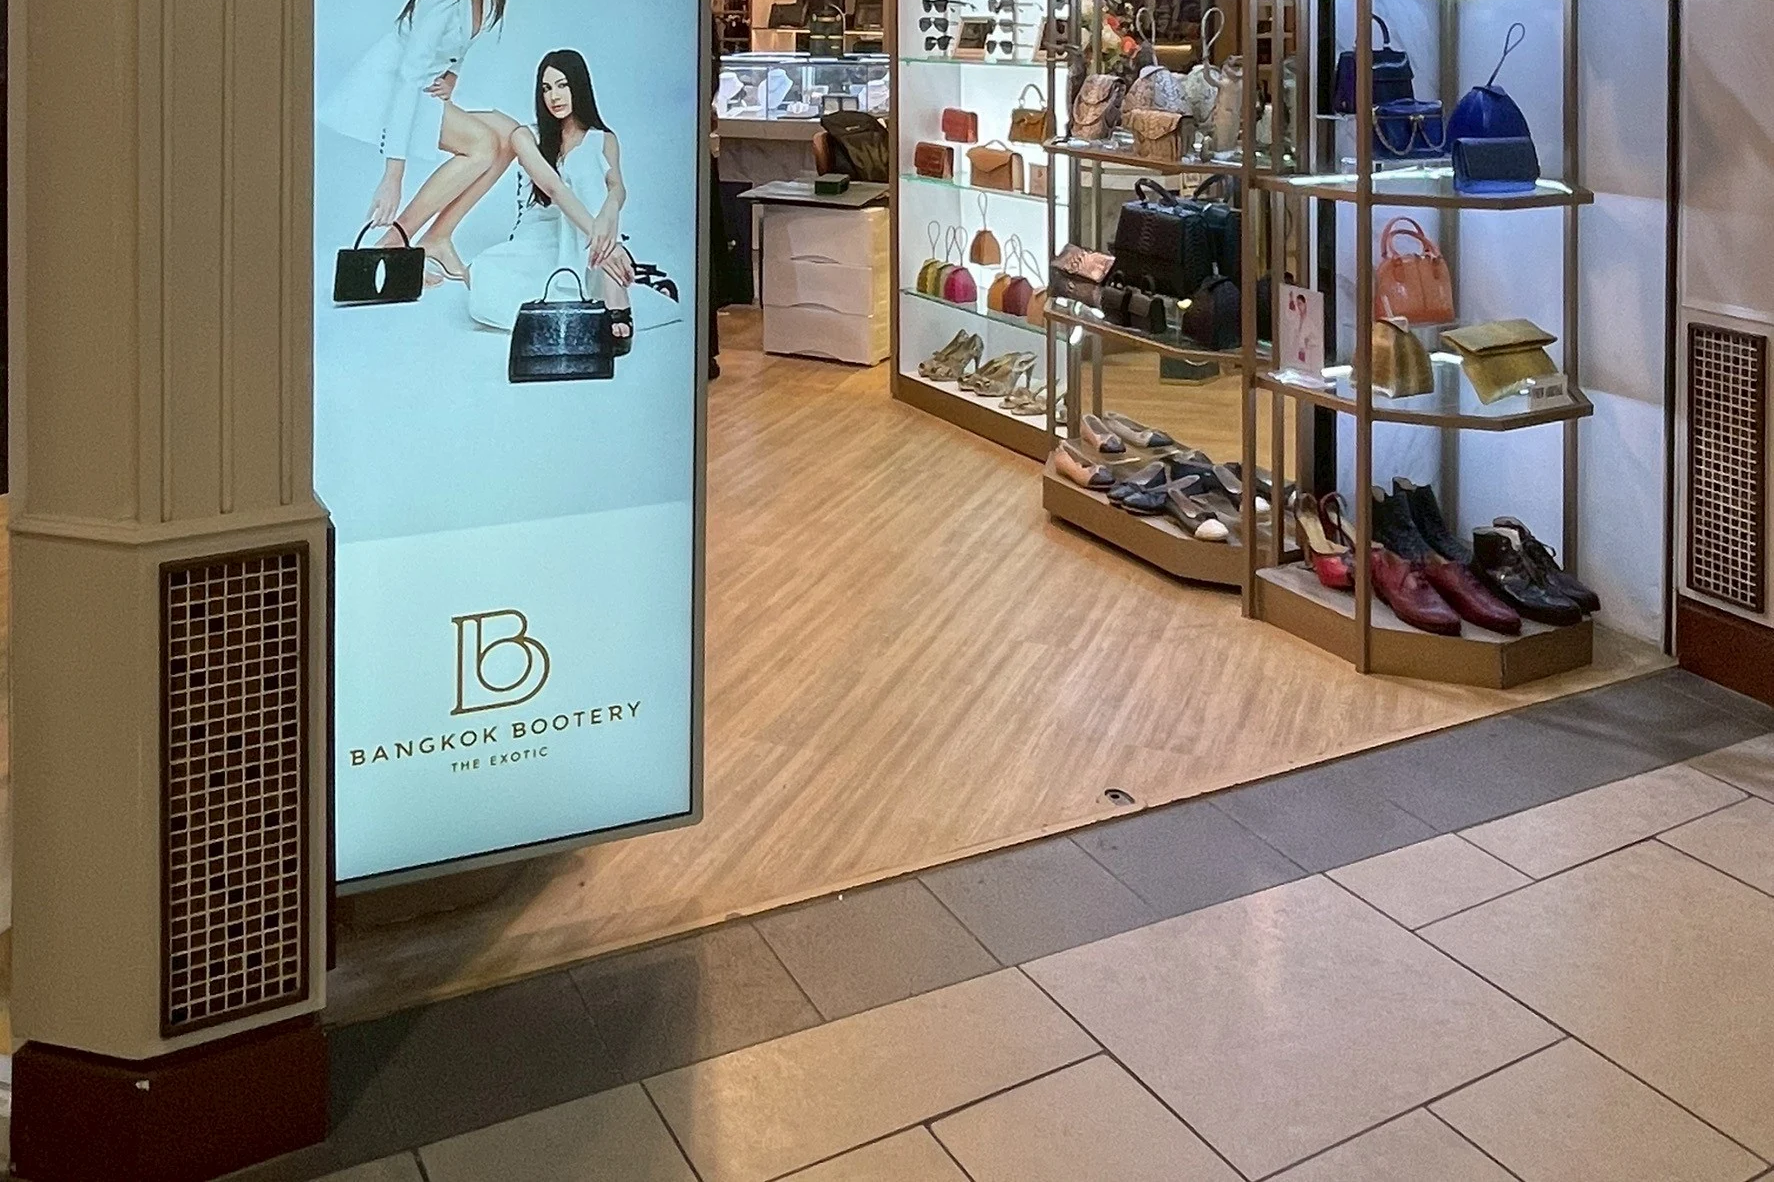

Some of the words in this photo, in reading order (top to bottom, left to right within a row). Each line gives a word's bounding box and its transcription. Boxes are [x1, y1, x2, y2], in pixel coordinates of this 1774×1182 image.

[349, 725, 498, 767] BANGKOK
[510, 700, 642, 740] BOOTERY
[450, 758, 481, 773] THE
[490, 746, 549, 767] EXOTIC
